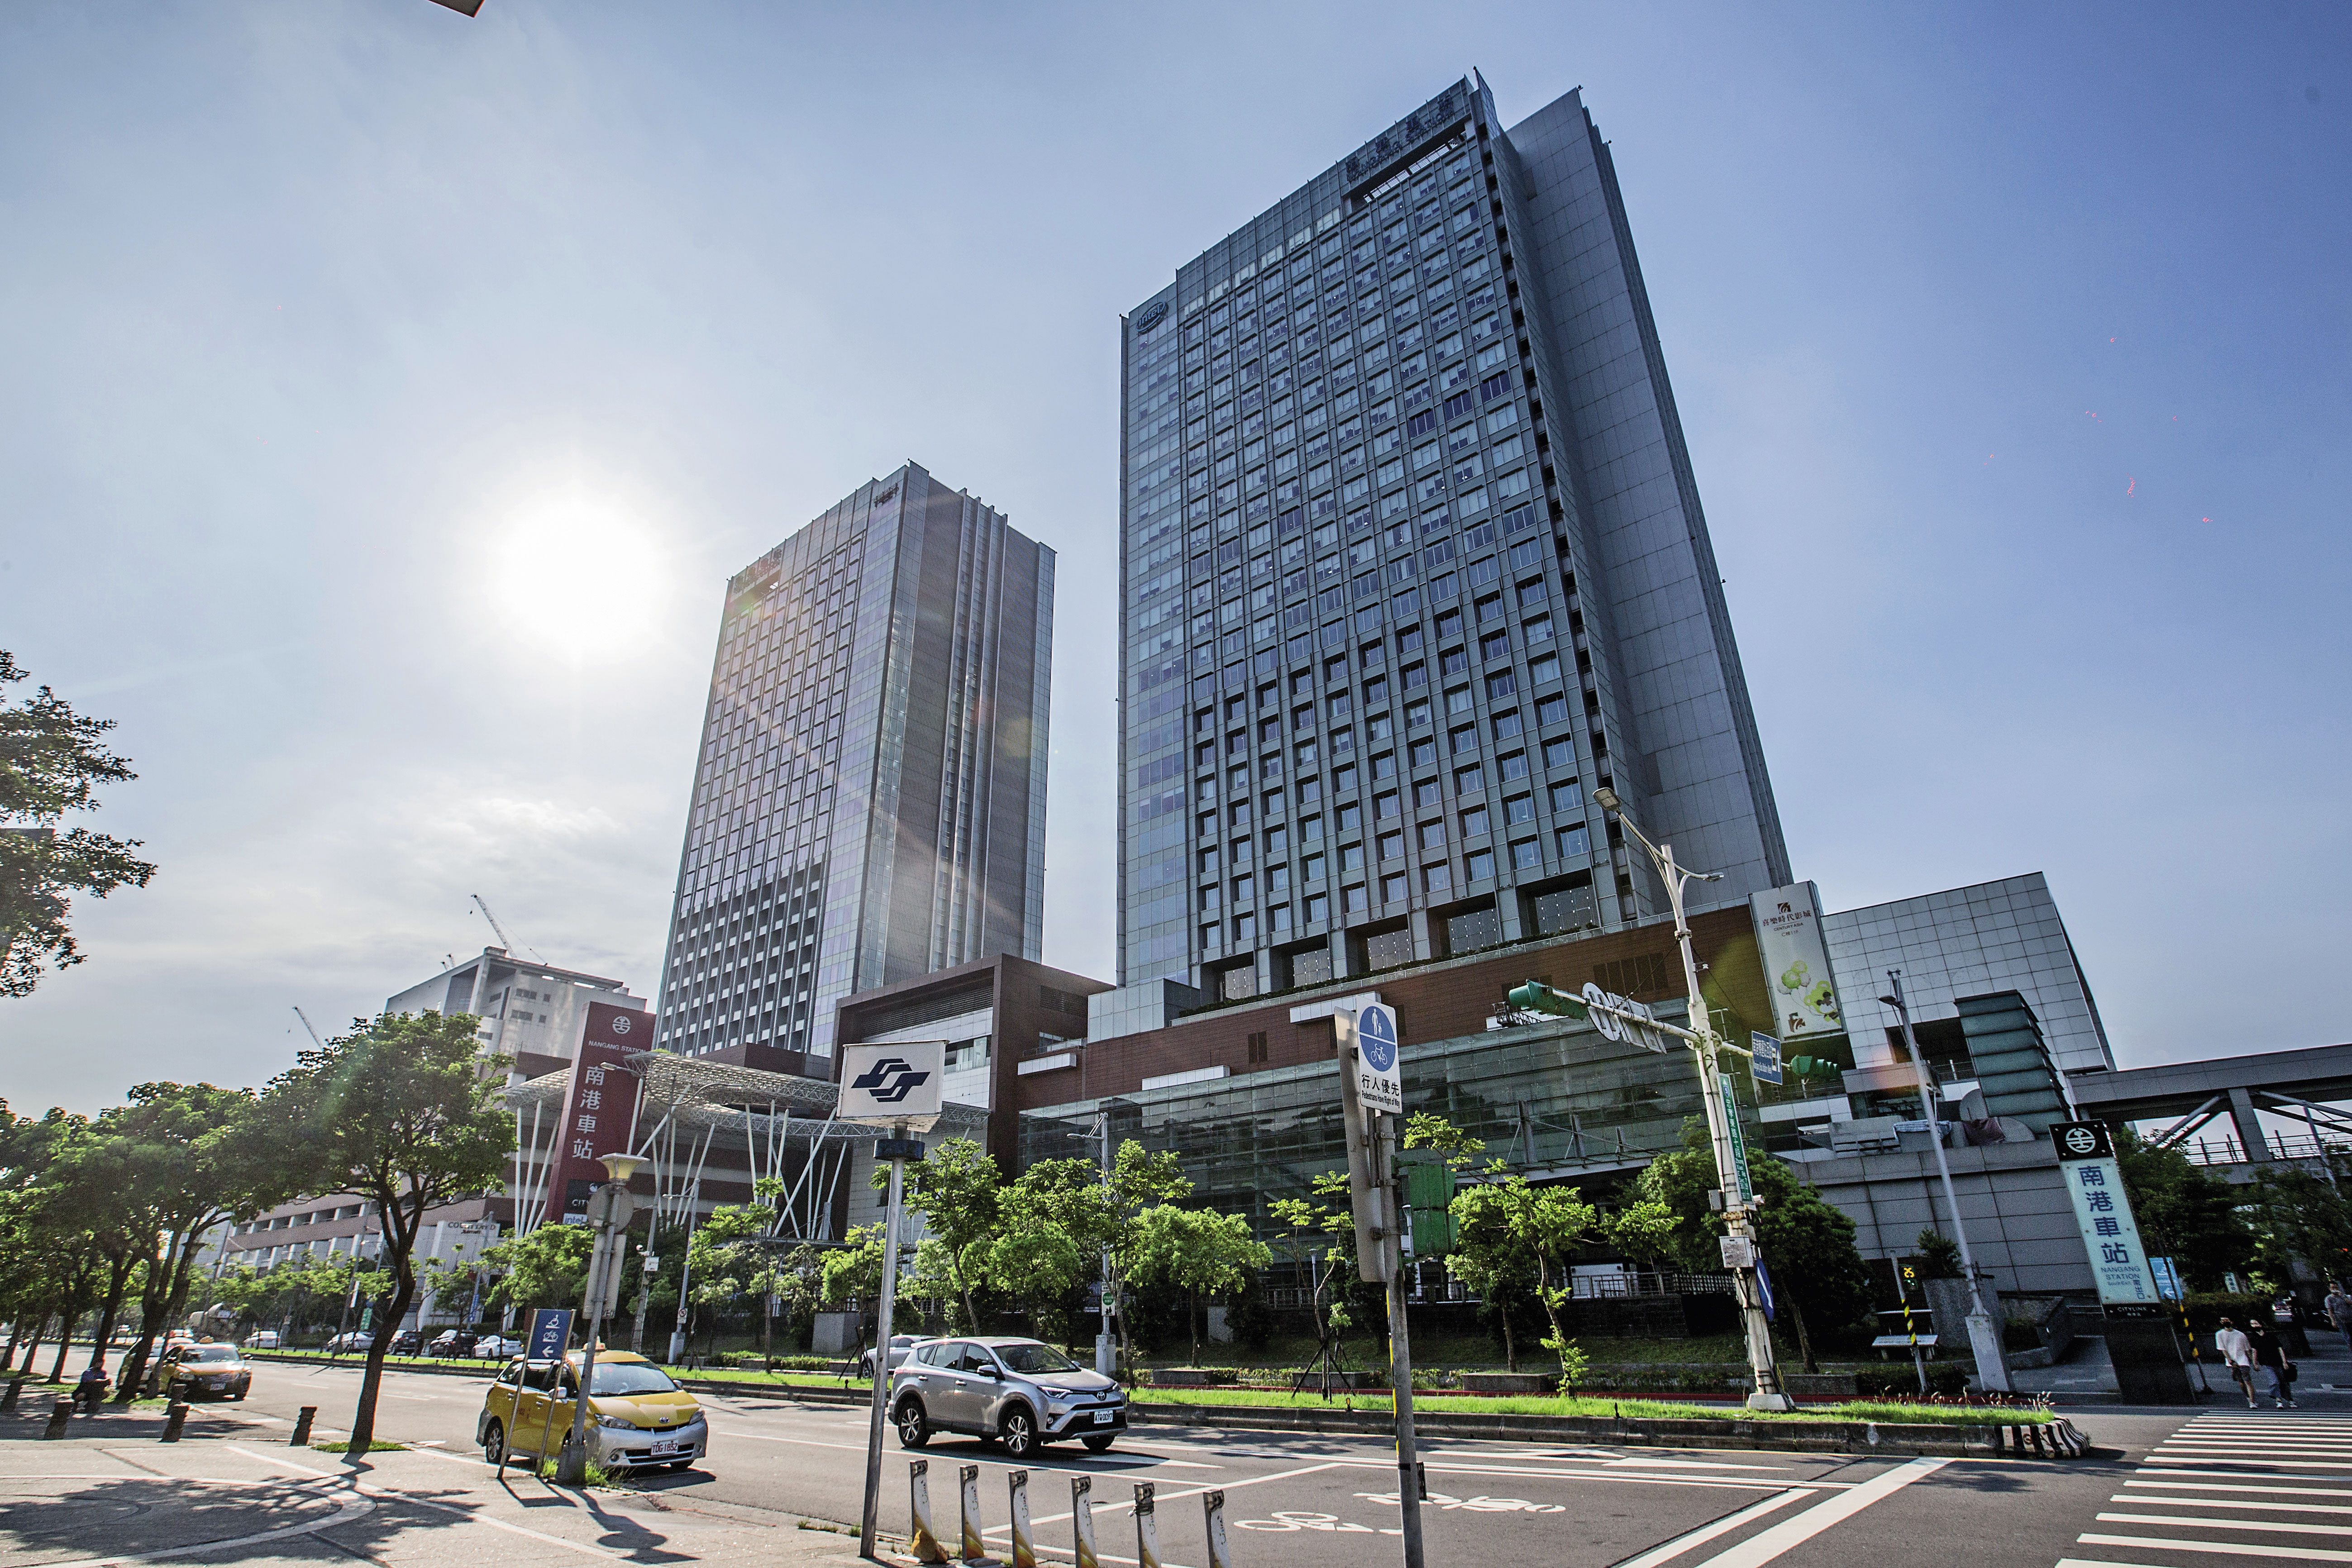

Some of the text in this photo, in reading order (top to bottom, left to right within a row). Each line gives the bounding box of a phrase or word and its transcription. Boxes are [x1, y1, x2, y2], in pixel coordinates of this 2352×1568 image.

[1139, 304, 1160, 325] intel
[1762, 910, 1811, 926] 喜樂時代影城
[589, 1040, 619, 1050] NANGANG
[1362, 1074, 1399, 1096] 行人優先
[572, 1066, 606, 1159] 南港車站
[2078, 1166, 2129, 1263] 南港車站
[1904, 1268, 1915, 1277] 25
